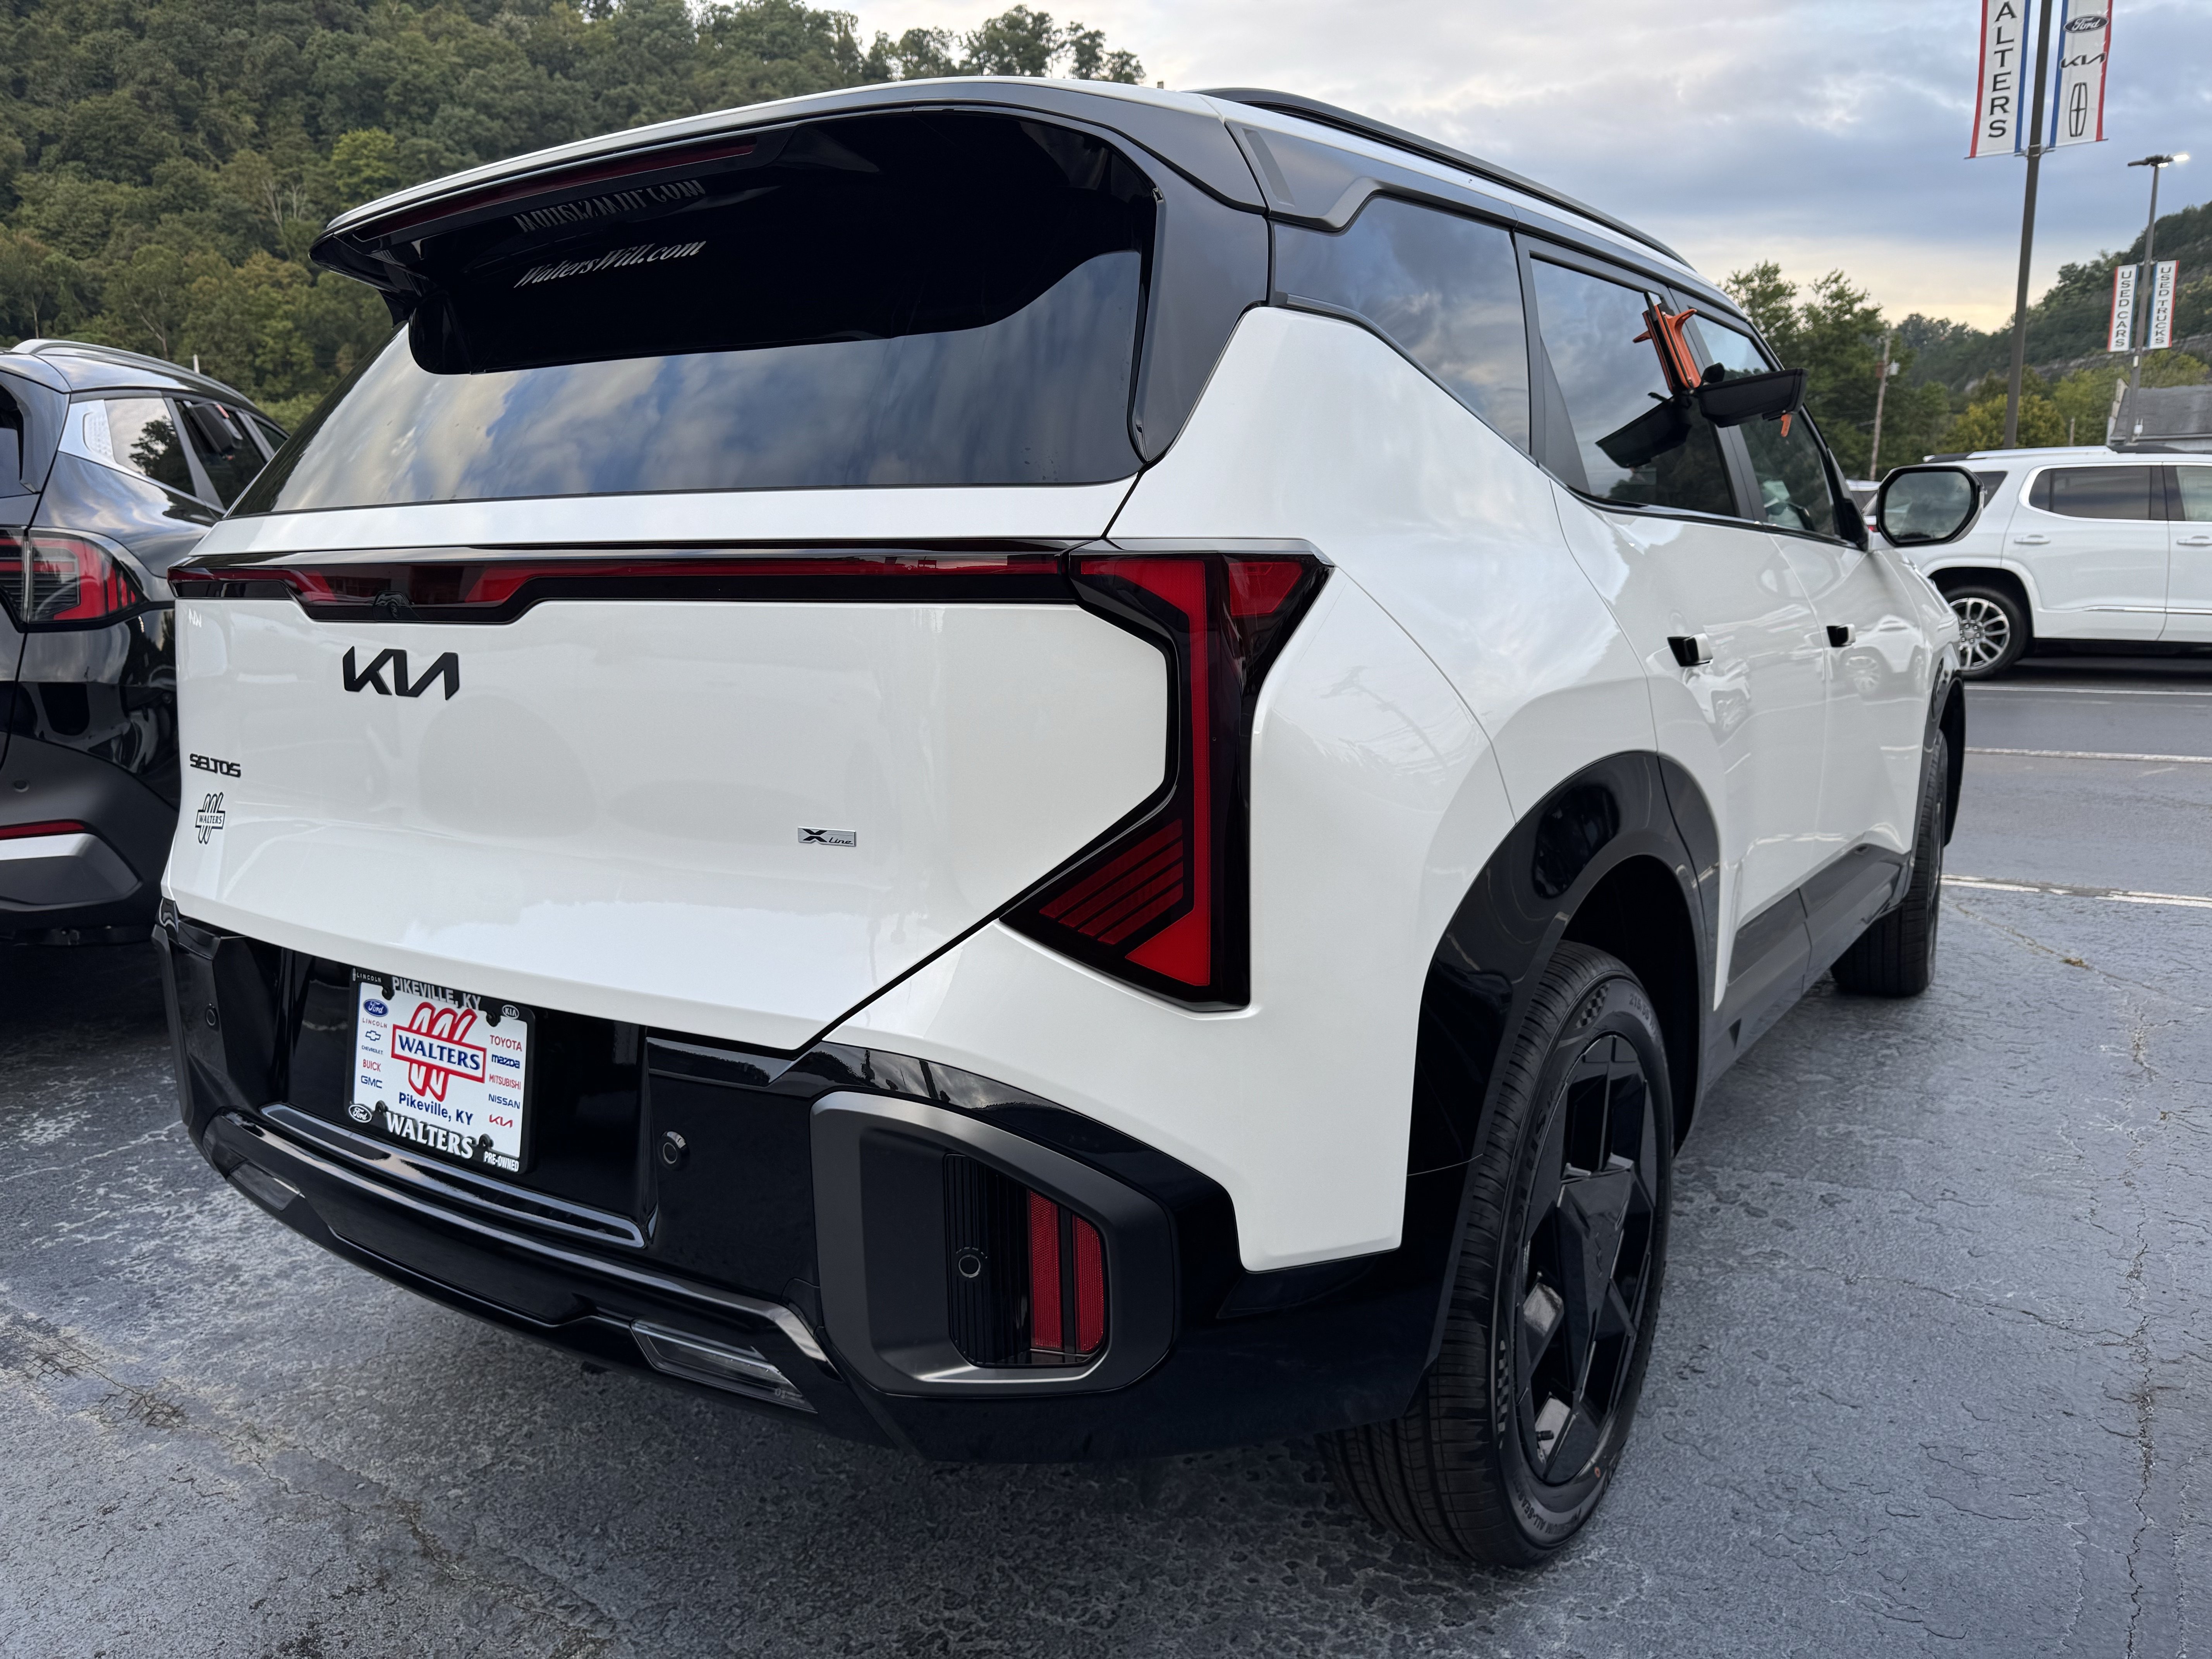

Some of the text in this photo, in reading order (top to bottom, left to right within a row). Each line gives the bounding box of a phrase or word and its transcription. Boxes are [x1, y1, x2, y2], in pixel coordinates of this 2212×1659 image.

[2072, 16, 2100, 31] Ford
[2061, 52, 2107, 69] KIA
[514, 240, 706, 288] WaltersWill.com
[2116, 270, 2132, 347] USED CARS
[2155, 267, 2171, 343] USED TRUCKS
[342, 646, 460, 701] KIA
[190, 753, 241, 778] SELTOS
[199, 814, 222, 825] WALTERS
[357, 972, 382, 982] LINCOLN
[392, 976, 481, 1010] PIKEVILLE, KY
[368, 1000, 383, 1014] Ford
[505, 1007, 517, 1017] KIA
[362, 1017, 388, 1029] LINCOLN
[362, 1045, 383, 1055] CHEVROLET
[490, 1034, 522, 1052] TOYOTA
[398, 1034, 480, 1070] WALTERS
[363, 1059, 381, 1072] BUICK
[491, 1054, 520, 1069] mazda
[361, 1075, 383, 1089] GMC
[489, 1073, 521, 1090] MITSUBISHI
[399, 1092, 474, 1125] Pikeville, KY
[488, 1093, 520, 1109] NISSAN
[353, 1107, 368, 1120] Ford
[489, 1114, 513, 1128] KIA
[386, 1111, 473, 1159] WALTERS
[484, 1151, 519, 1172] PRE-OWNED
